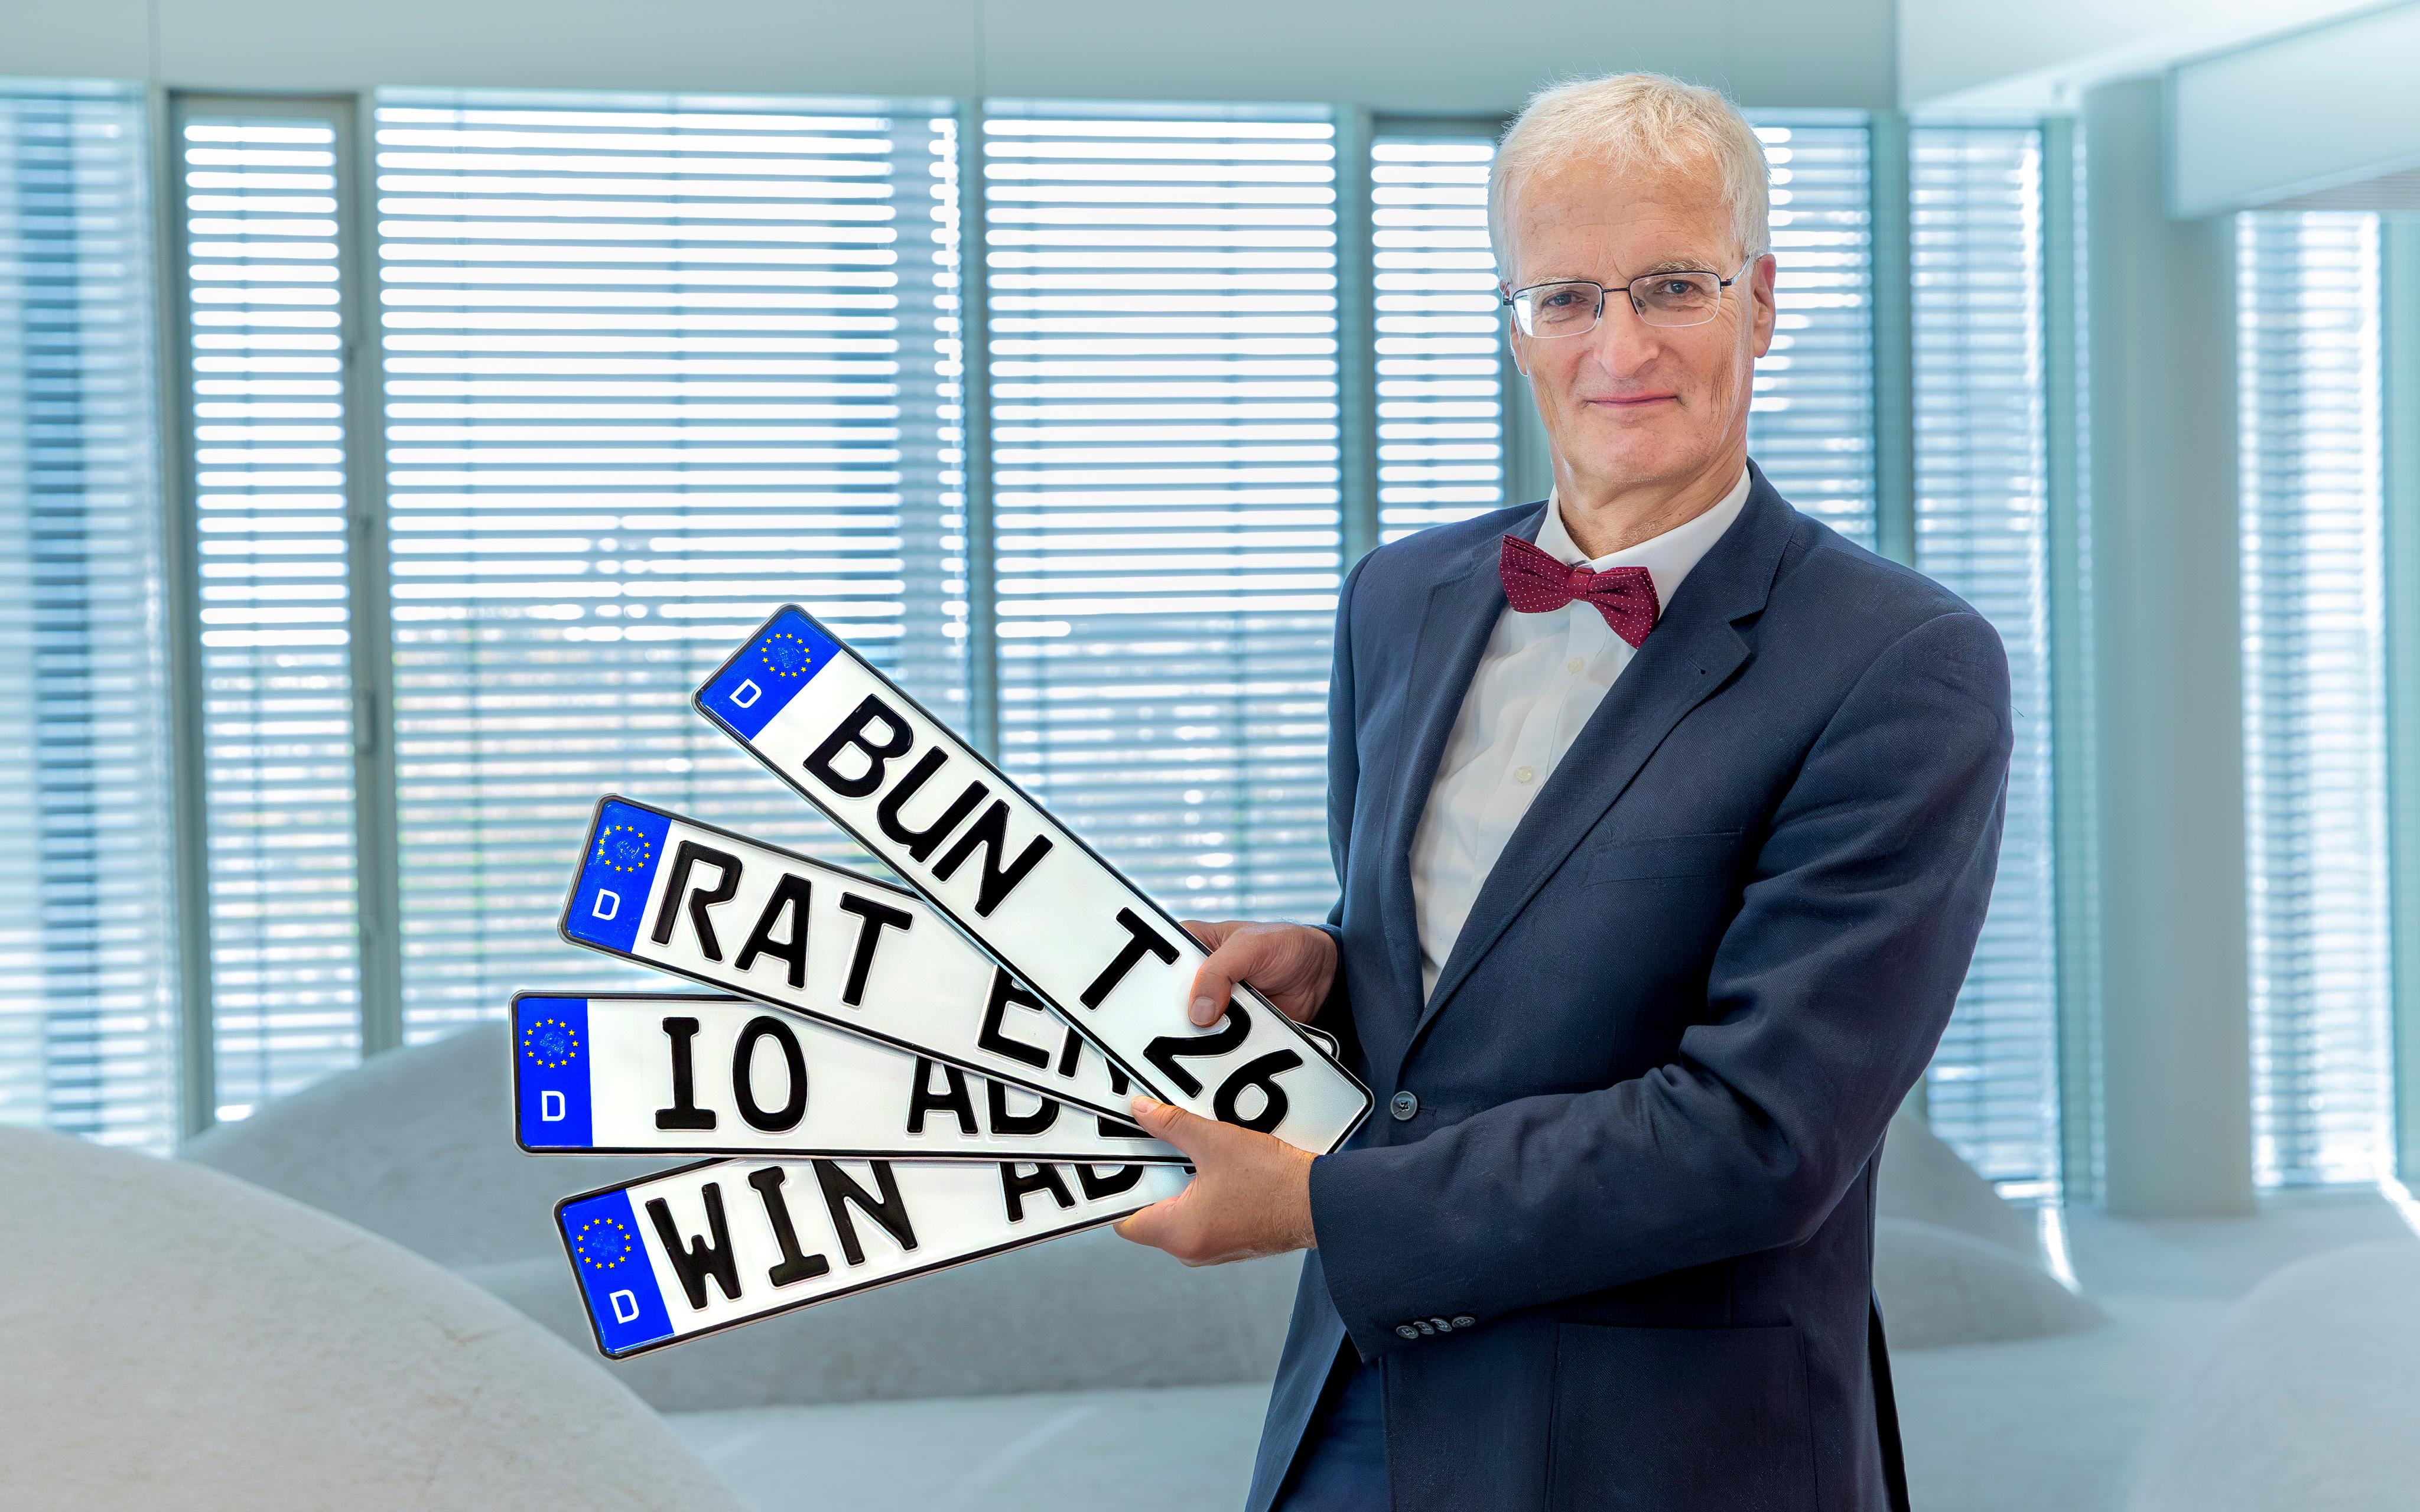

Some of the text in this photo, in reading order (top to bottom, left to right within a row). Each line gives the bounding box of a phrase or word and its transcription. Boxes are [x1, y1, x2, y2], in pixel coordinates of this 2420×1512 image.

[728, 678, 762, 708] D
[591, 888, 620, 921] D
[650, 840, 913, 1006] RAT
[802, 693, 1303, 1135] BUN T 26
[541, 1090, 565, 1122] D
[655, 1015, 808, 1132] IO
[645, 1159, 918, 1310] WIN
[609, 1289, 640, 1324] D
